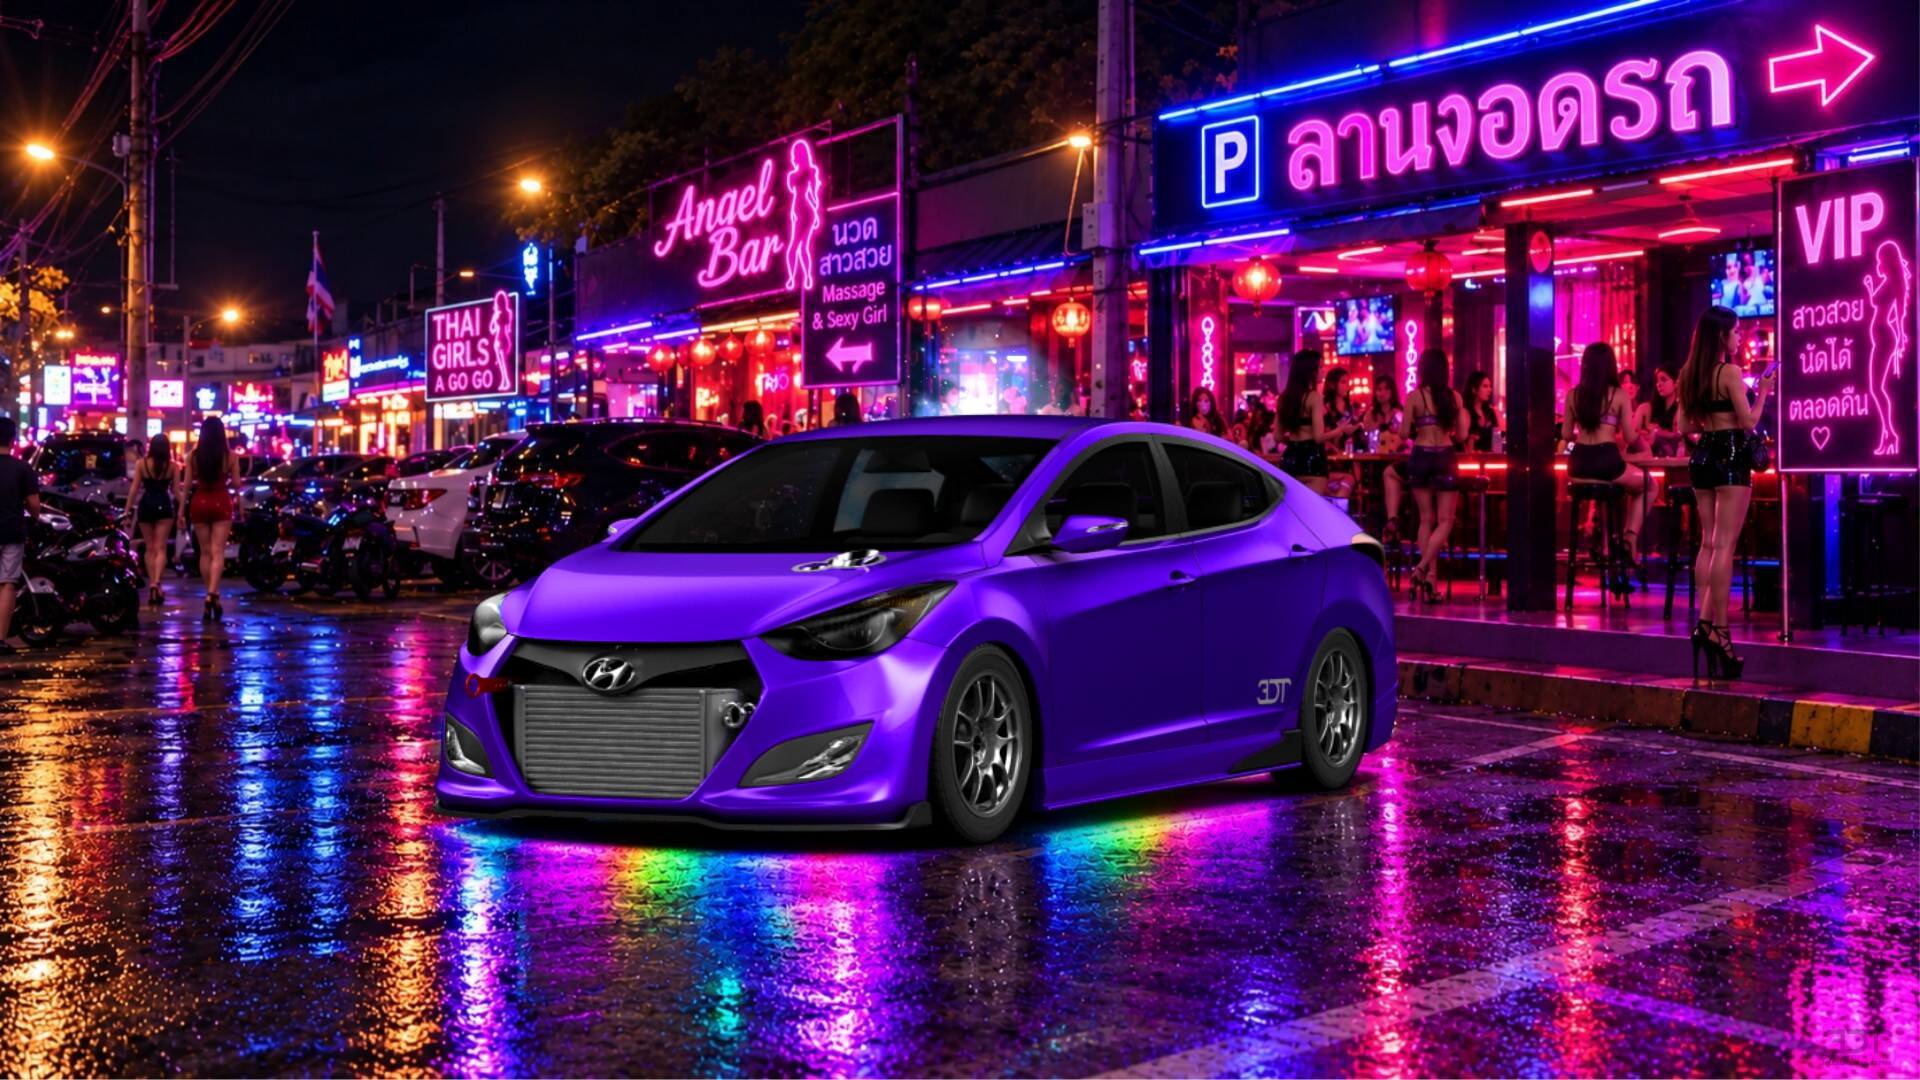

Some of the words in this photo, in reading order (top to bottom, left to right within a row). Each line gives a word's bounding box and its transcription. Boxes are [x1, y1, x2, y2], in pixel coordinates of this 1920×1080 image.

[1214, 130, 1249, 195] P
[832, 217, 878, 247] นวด
[1795, 191, 1885, 265] VIP
[697, 226, 785, 288] Bar
[819, 244, 892, 276] สาวสวย
[823, 281, 885, 303] Massage
[432, 307, 480, 341] THAI
[812, 312, 824, 331] &
[827, 310, 859, 331] Sexy
[863, 303, 887, 324] Girl
[1793, 299, 1864, 330] สาวสวย
[432, 337, 490, 370] GIRLS
[434, 375, 445, 393] A
[447, 371, 468, 391] GO
[472, 369, 493, 389] GO
